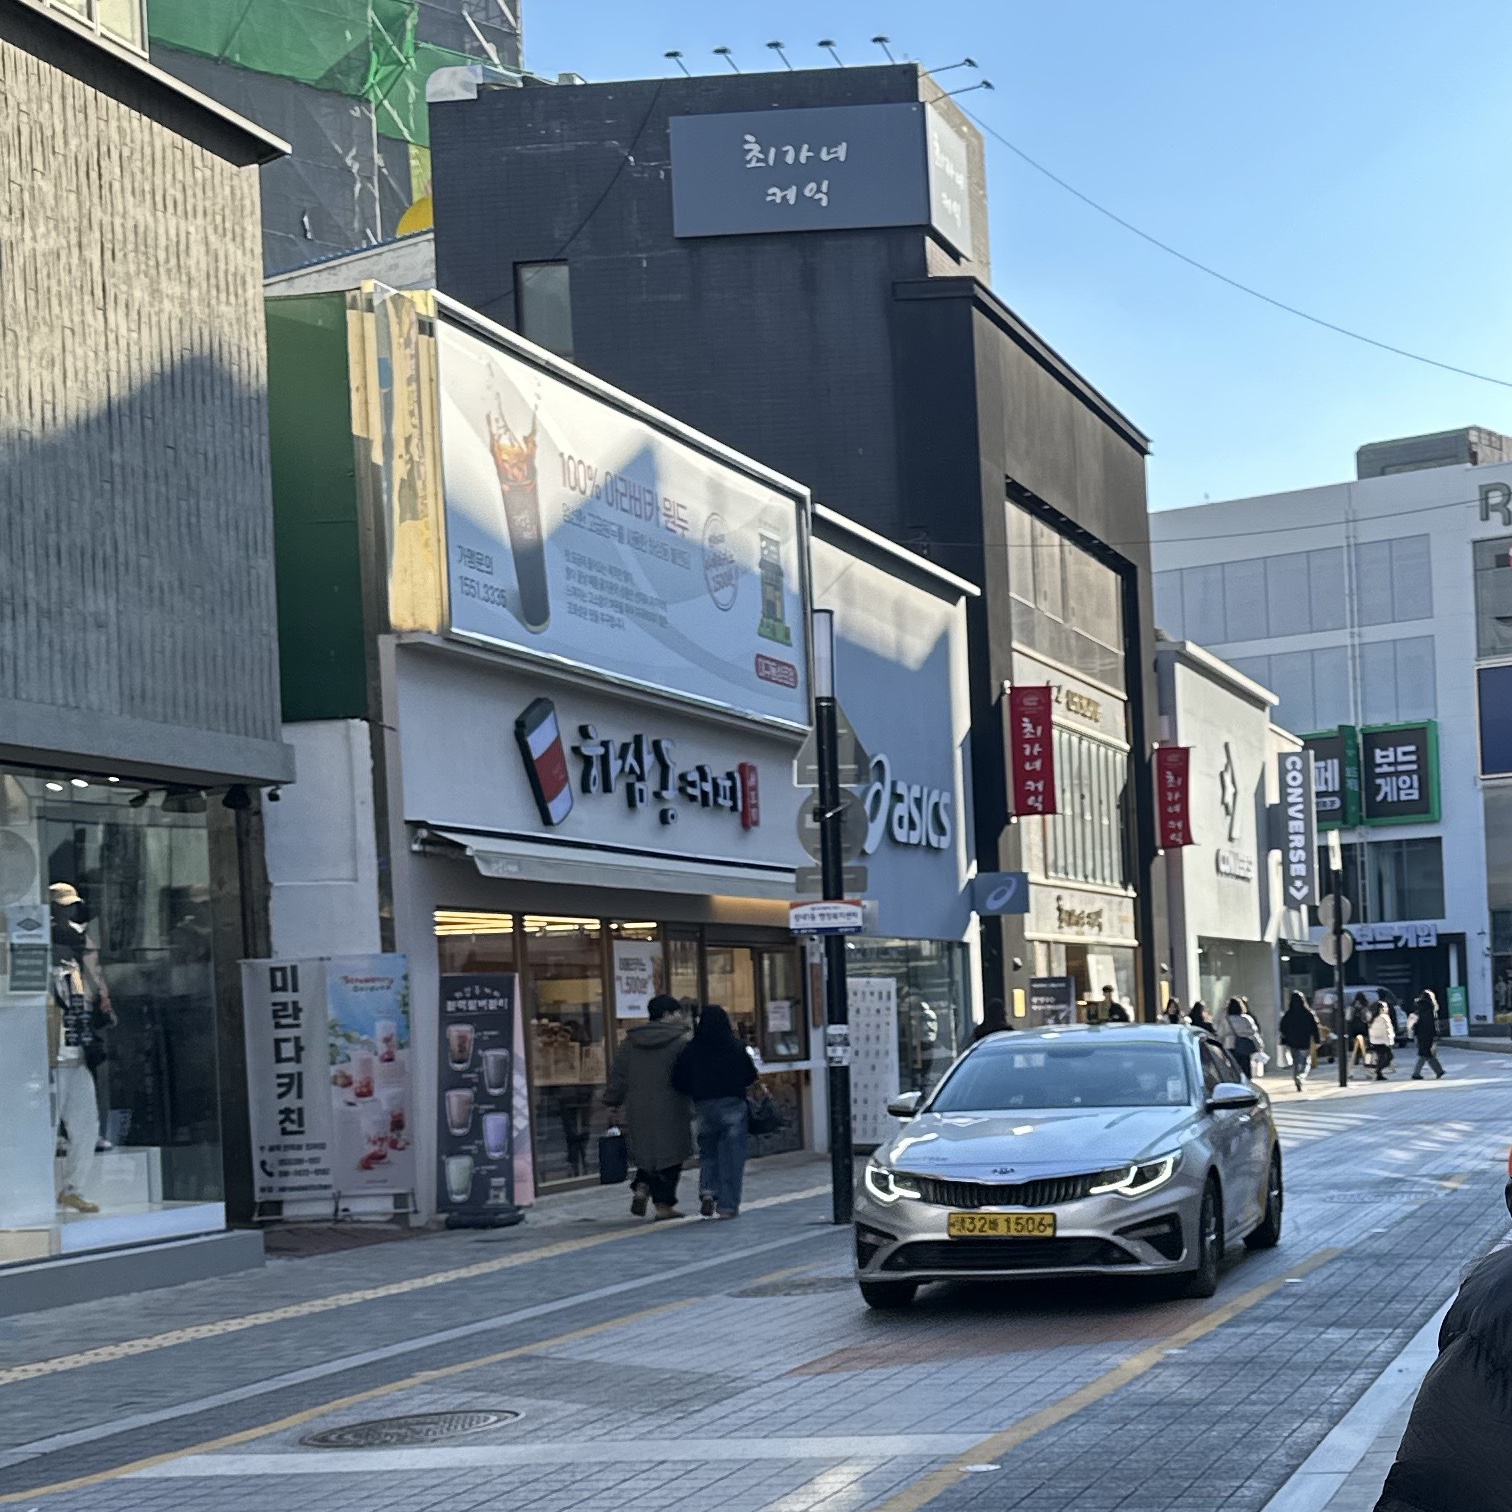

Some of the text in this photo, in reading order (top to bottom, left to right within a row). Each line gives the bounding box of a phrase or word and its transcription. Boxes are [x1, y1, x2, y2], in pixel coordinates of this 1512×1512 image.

[743, 133, 848, 169] 최가네
[766, 179, 829, 207] 케익
[559, 451, 602, 500] 100%
[662, 496, 690, 539] 원두
[570, 724, 743, 826] 하삼동커피
[1373, 744, 1418, 774] 보드
[891, 780, 952, 850] asics
[1374, 774, 1420, 803] 게임
[1284, 755, 1307, 877] CONVERSE
[268, 964, 306, 1137] 미란다키친
[1004, 1216, 1048, 1234] 1506
